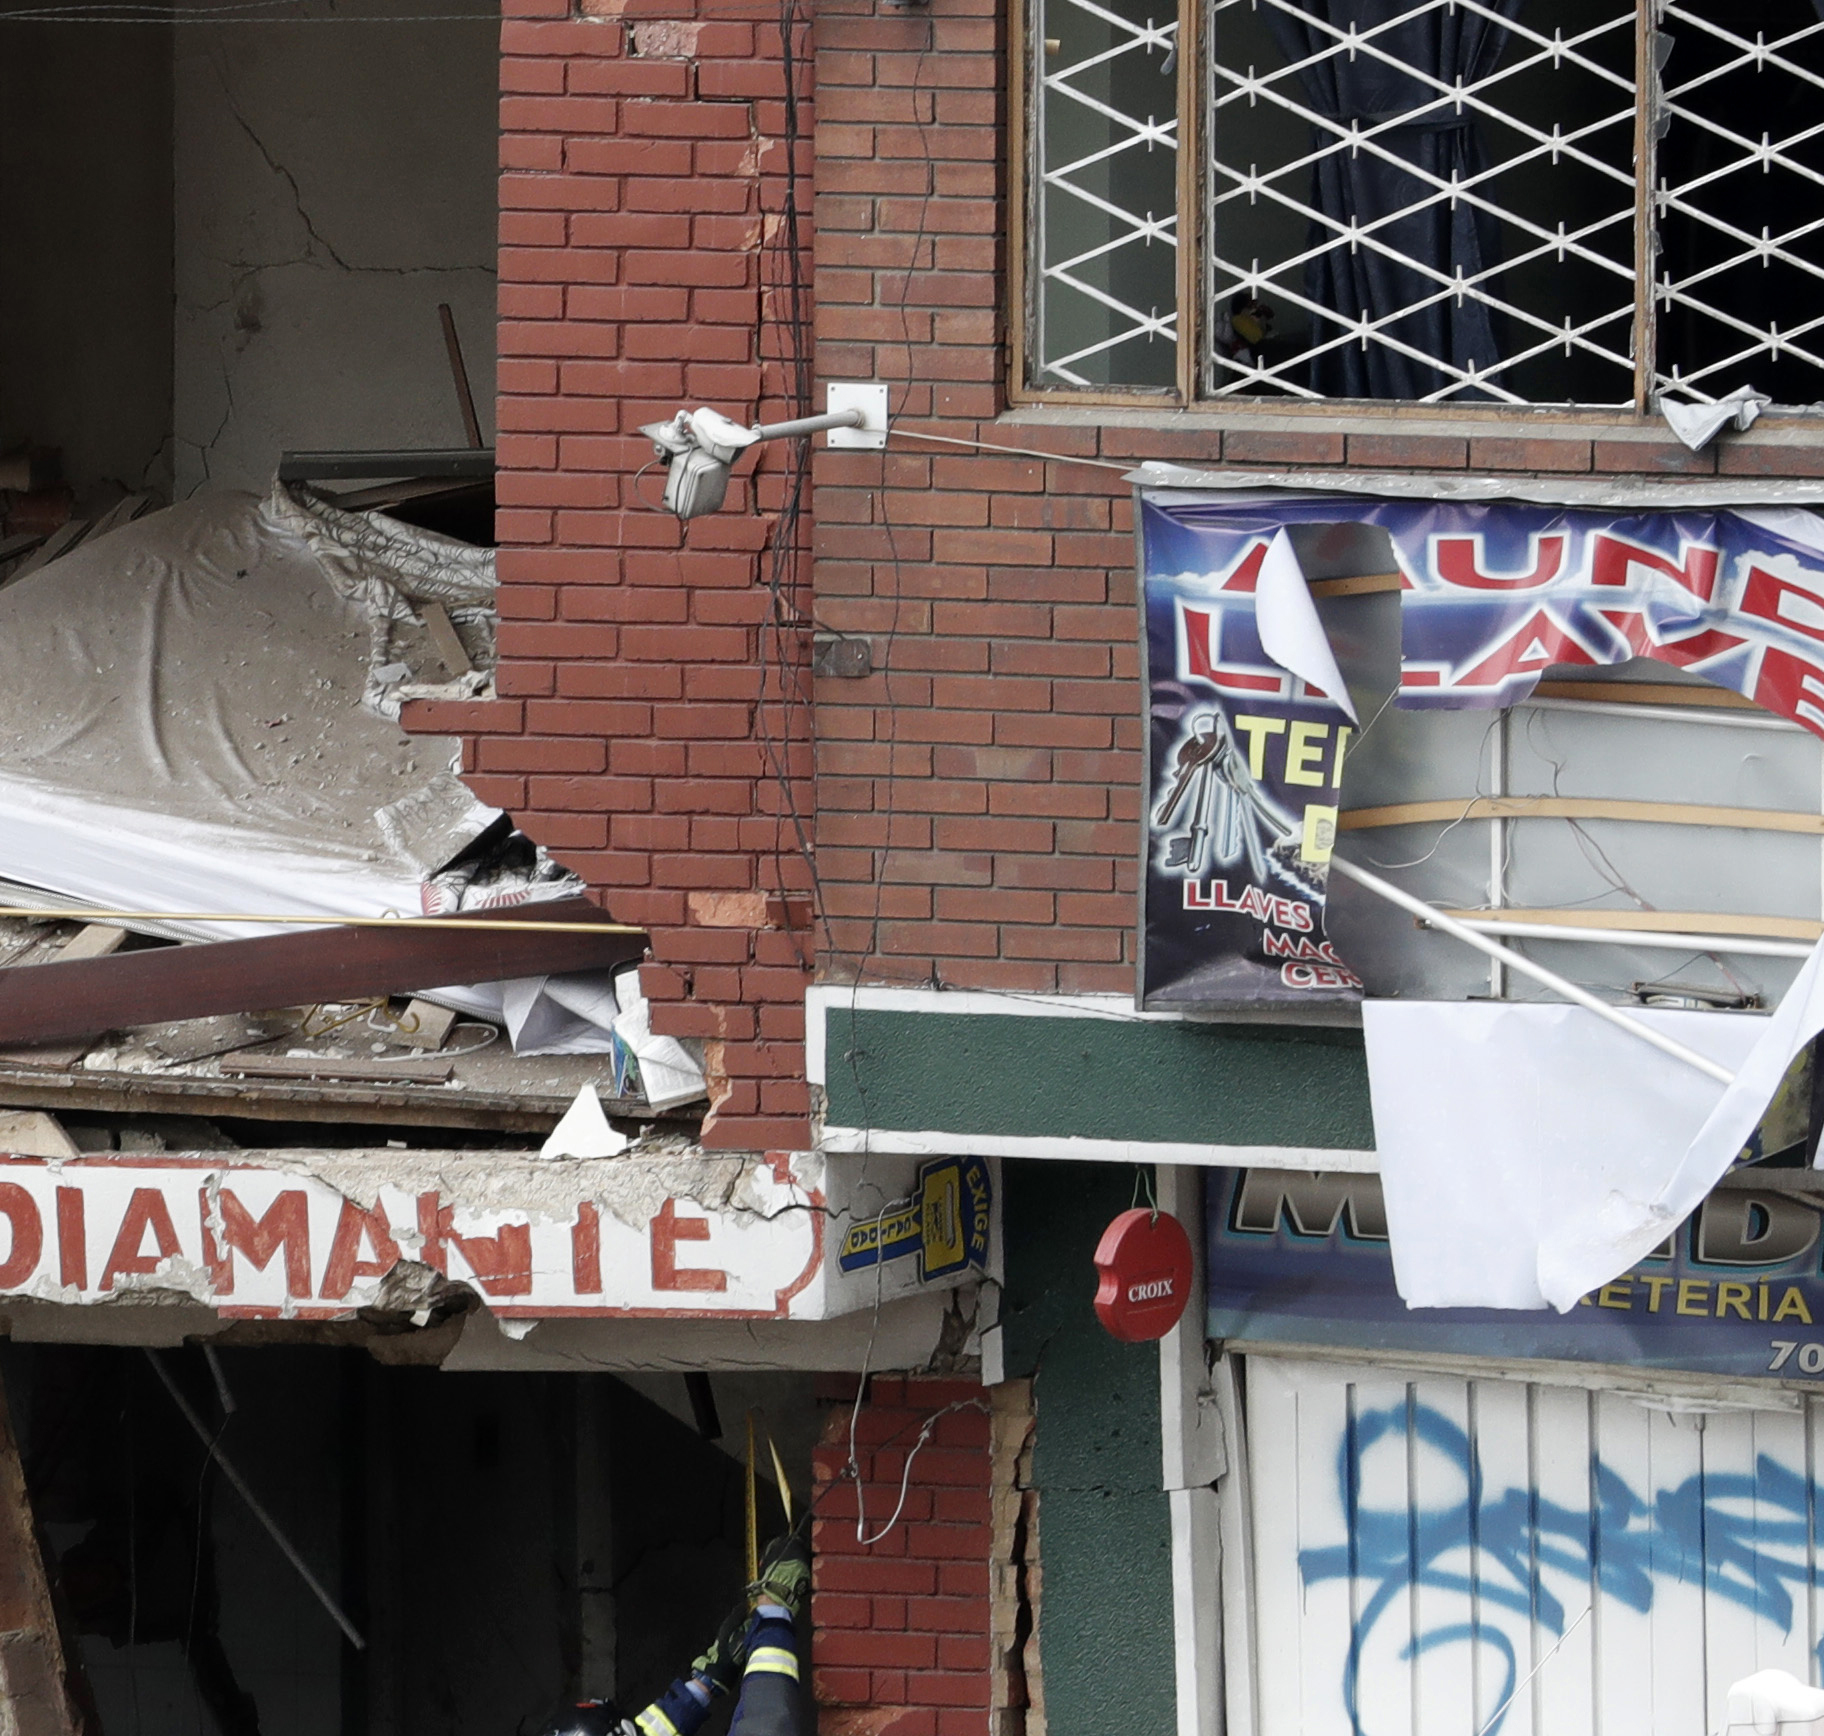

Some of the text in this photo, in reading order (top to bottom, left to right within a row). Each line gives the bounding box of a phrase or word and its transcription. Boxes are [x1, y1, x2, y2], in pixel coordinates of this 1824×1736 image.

[1183, 879, 1313, 932] LLAVES
[966, 1164, 989, 1252] EXIGE
[1128, 1279, 1174, 1302] CROIX
